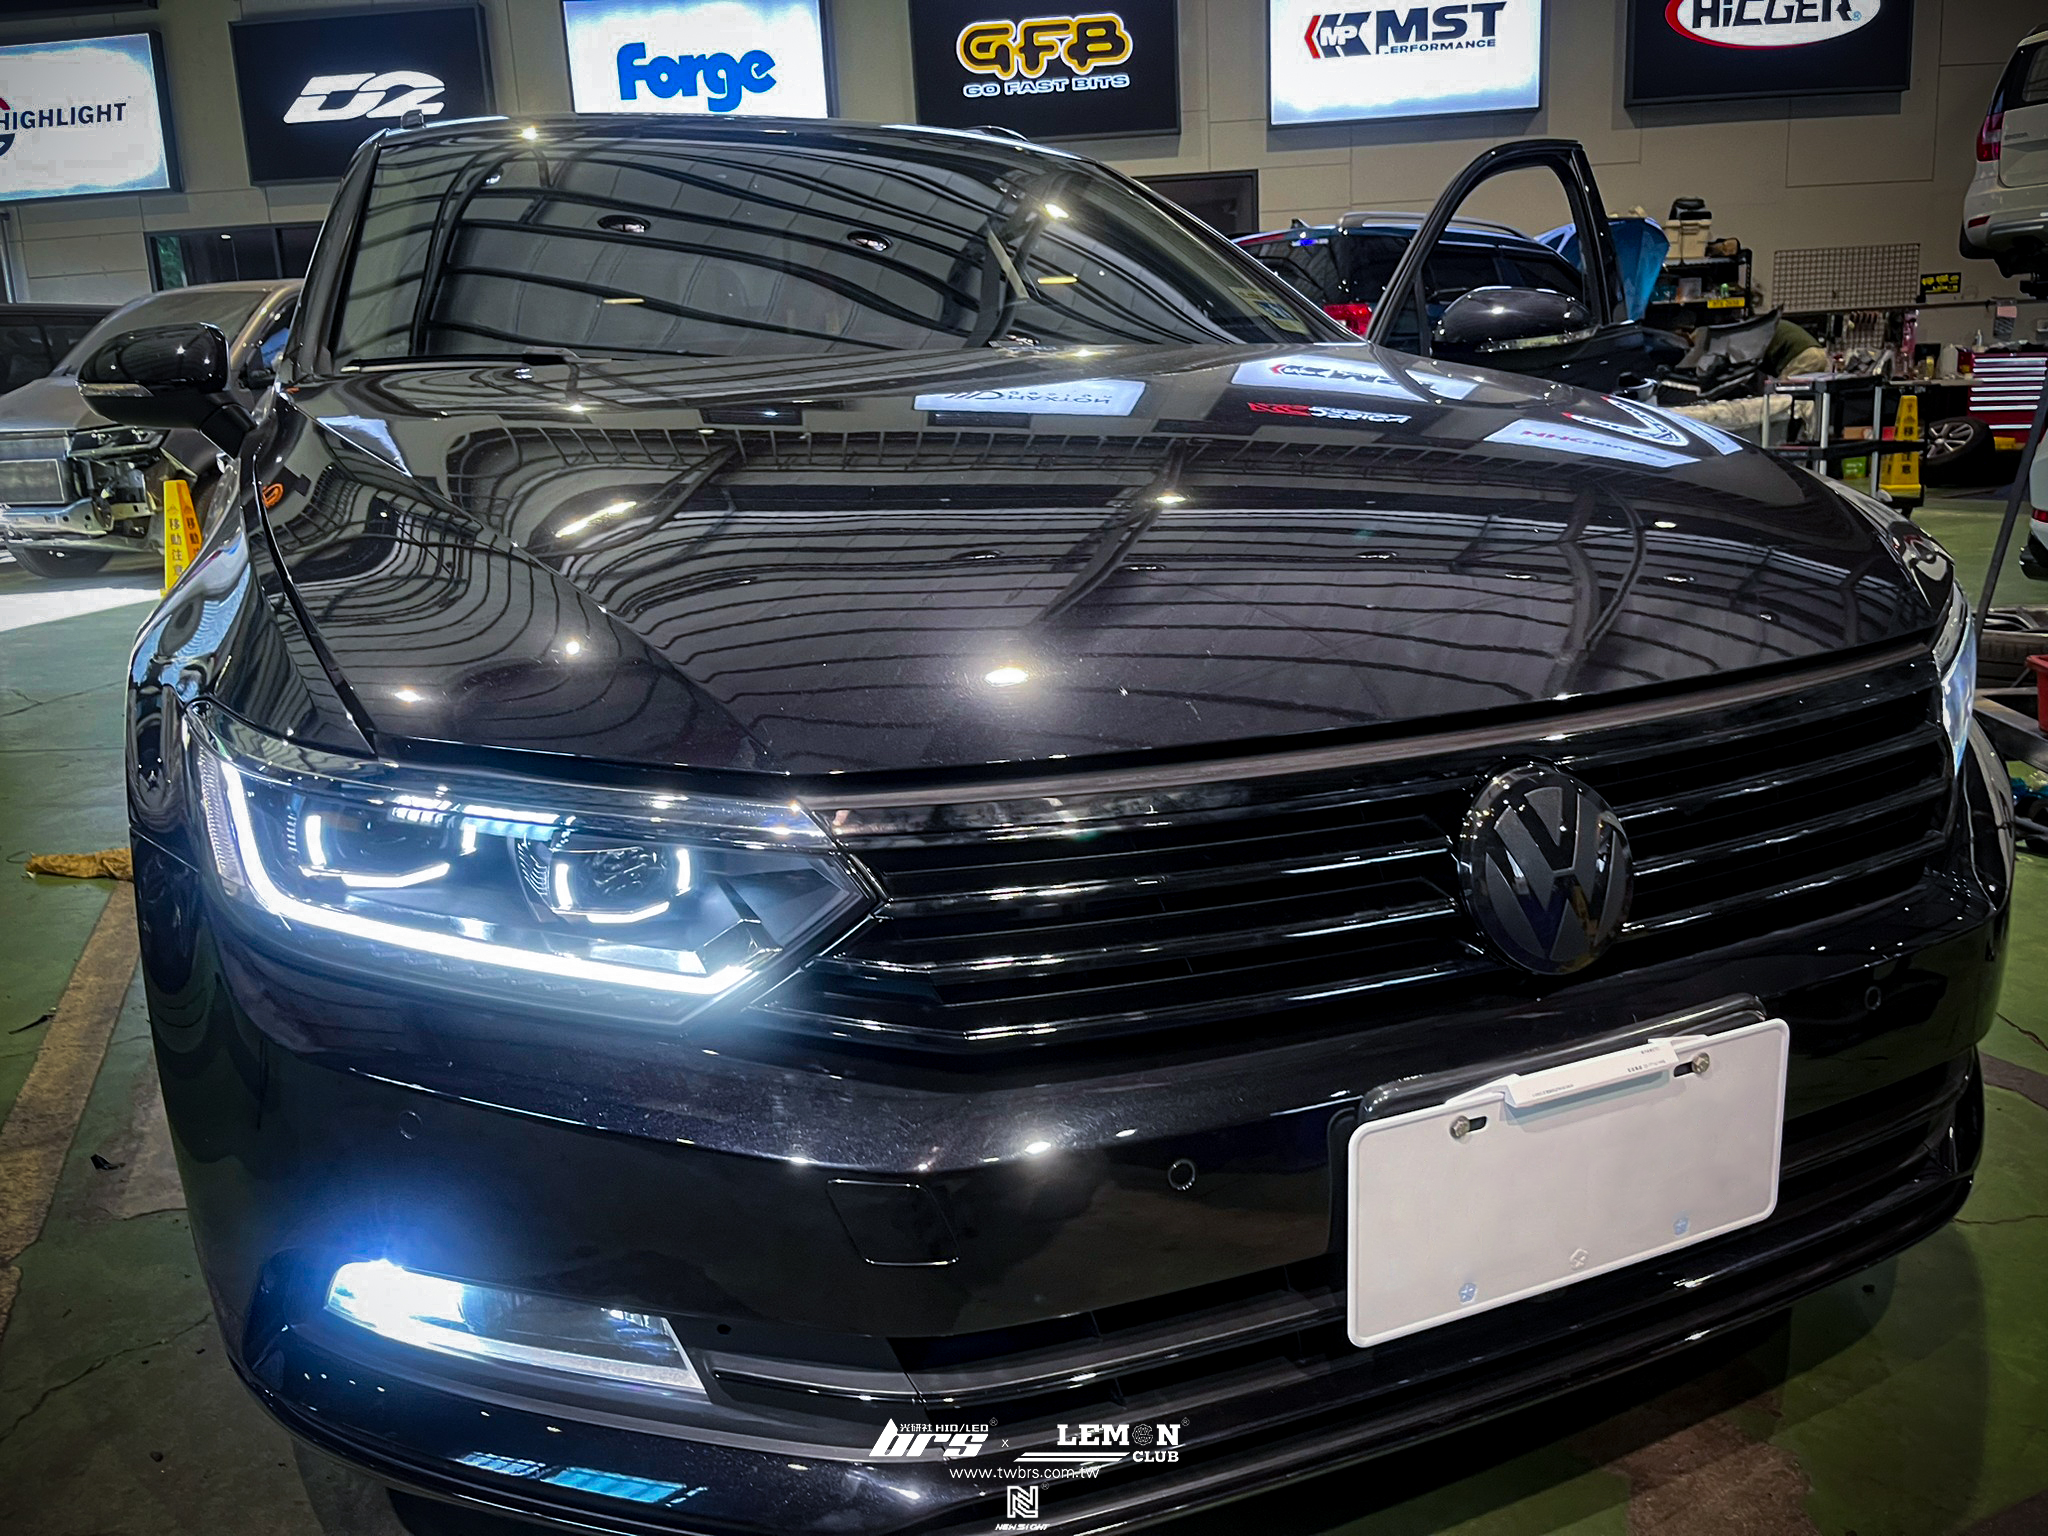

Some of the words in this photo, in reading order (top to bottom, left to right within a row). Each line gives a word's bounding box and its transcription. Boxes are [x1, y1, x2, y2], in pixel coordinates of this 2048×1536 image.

[957, 13, 1133, 80] GFB
[1376, 1, 1507, 45] MST
[283, 70, 446, 124] D2
[616, 42, 777, 112] Forge
[963, 82, 1000, 98] GO
[1004, 78, 1069, 96] FAST
[1072, 73, 1130, 91] BITS
[0, 103, 126, 130] HIGHLIGHT
